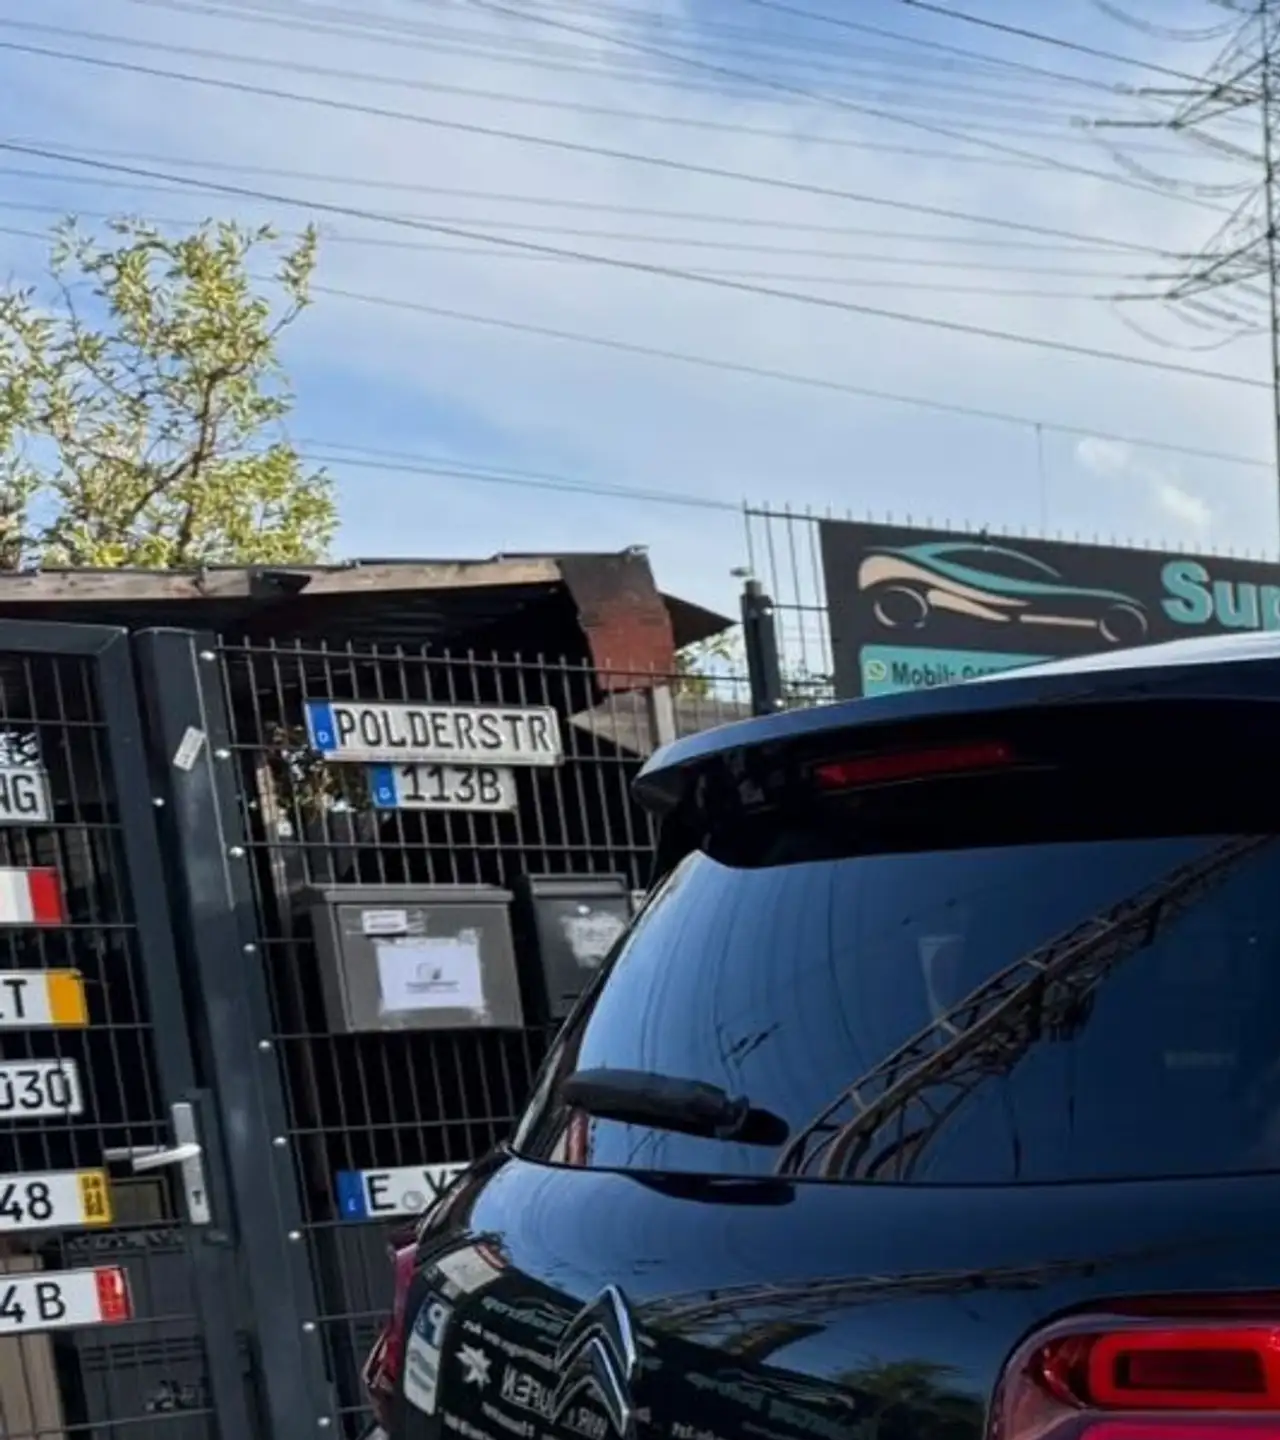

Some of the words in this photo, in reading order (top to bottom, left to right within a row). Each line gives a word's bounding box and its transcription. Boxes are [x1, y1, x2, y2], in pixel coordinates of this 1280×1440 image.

[334, 708, 552, 752] POLDERSTR
[402, 765, 501, 804] 113B
[0, 1181, 54, 1223] 48
[366, 1173, 397, 1211] E
